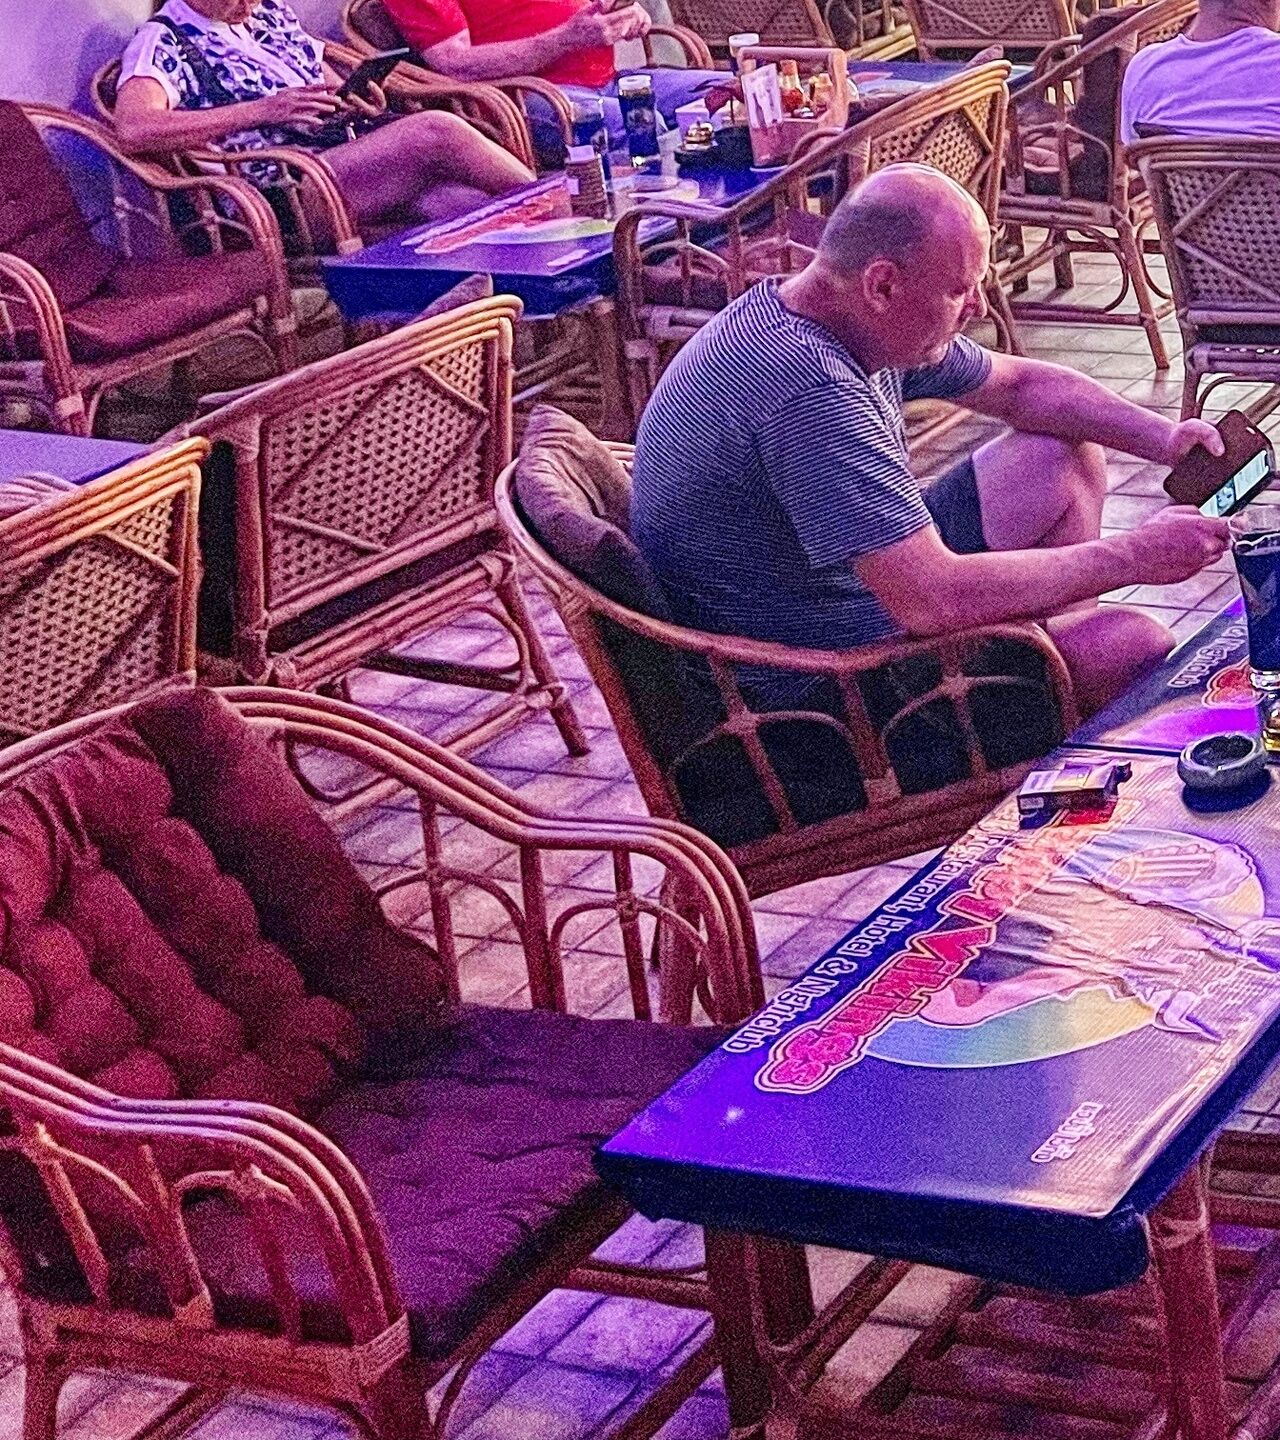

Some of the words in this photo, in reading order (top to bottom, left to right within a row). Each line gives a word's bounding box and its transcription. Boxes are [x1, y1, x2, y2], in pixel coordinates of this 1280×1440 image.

[837, 913, 913, 964] Hotel
[814, 958, 858, 977] &
[724, 975, 840, 1052] Nightclub
